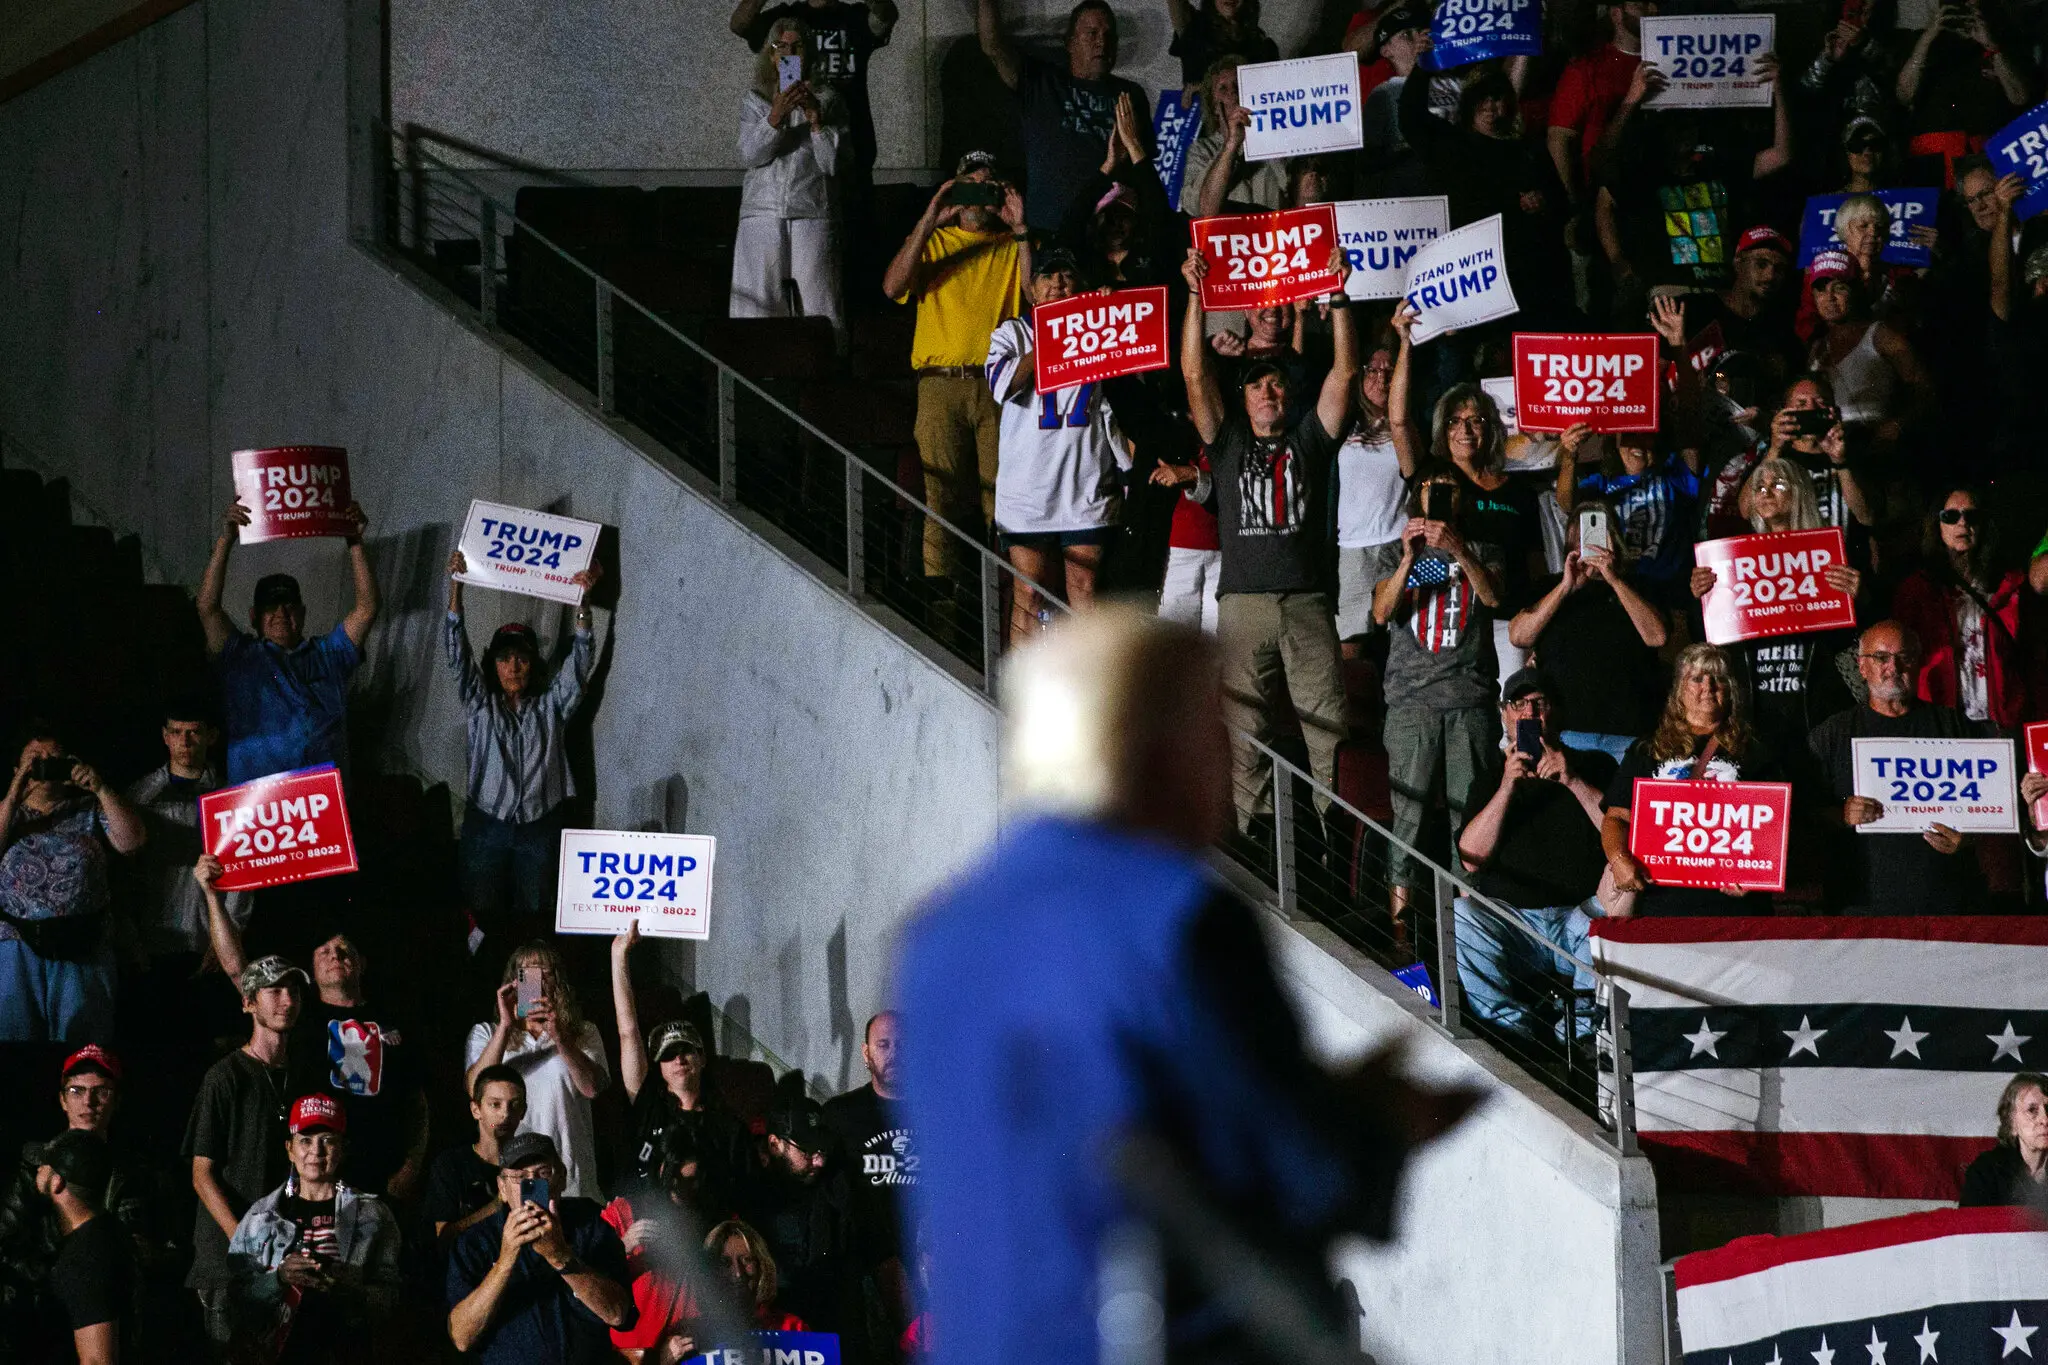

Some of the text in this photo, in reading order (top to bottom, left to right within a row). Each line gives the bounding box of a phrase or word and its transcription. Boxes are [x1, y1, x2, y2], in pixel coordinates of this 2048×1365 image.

[1441, 12, 1515, 39] 2024
[1451, 36, 1483, 48] TRUMP
[1501, 33, 1532, 41] 88022
[1656, 34, 1761, 55] TRUMP
[1672, 56, 1745, 78] 2024
[1251, 83, 1349, 105] I STAND WITH
[1681, 81, 1714, 90] TRUMP
[1250, 100, 1351, 132] TRUMP
[1152, 102, 1176, 172] UMP
[1159, 116, 1185, 186] 2024
[1818, 202, 1924, 226] TMP
[1208, 223, 1324, 257] TRUMP
[1394, 227, 1438, 241] WITH
[1228, 248, 1310, 280] 2024
[1346, 245, 1427, 271] RUM
[1414, 263, 1454, 286] STAND
[1459, 248, 1494, 269] WITH
[1212, 268, 1331, 293] TEXT TRUMP TO 88022
[1408, 265, 1497, 311] TRUMP
[1046, 302, 1154, 341] TRUMP
[1062, 323, 1139, 359] 2024
[1047, 344, 1157, 375] TEXT TRUMP TO 88022
[1527, 353, 1644, 379] TRUMP
[1543, 378, 1628, 403] 2024
[1528, 404, 1647, 415] TEXT TRUMP TO 88022
[247, 464, 342, 489] TRUMP
[265, 485, 336, 511] 2024
[277, 511, 312, 521] TRUMP
[481, 518, 582, 551] TRUMP
[487, 541, 560, 569] 2024
[1711, 549, 1832, 584] TRUMP
[495, 563, 527, 575] TRUMP
[529, 569, 542, 578] TO
[544, 574, 574, 585] 88022
[1732, 574, 1820, 607] 2024
[1747, 605, 1786, 618] TRUMP
[1788, 603, 1804, 613] TO
[1807, 600, 1841, 611] 88022
[1769, 676, 1800, 692] 1776
[1870, 758, 1998, 779] TRUMP
[1890, 780, 1981, 801] 2024
[214, 793, 330, 835] TRUMP
[1649, 800, 1774, 830] TRUMP
[1904, 806, 1944, 814] TRUMP
[1949, 806, 1963, 814] TO
[1967, 806, 2003, 814] 88022
[233, 821, 319, 858] 2024
[1663, 827, 1754, 856] 2024
[225, 844, 342, 873] EXT TRUMP TO 88022
[577, 852, 697, 877] TRUMP
[1642, 854, 1773, 870] TEXT TRUMP TO 88022
[592, 877, 678, 901] 2024
[572, 903, 697, 916] TEXT TRUMP TO 88022
[864, 1129, 914, 1148] UNIVERSI
[862, 1154, 920, 1174] DD-2
[871, 1171, 918, 1187] Alum
